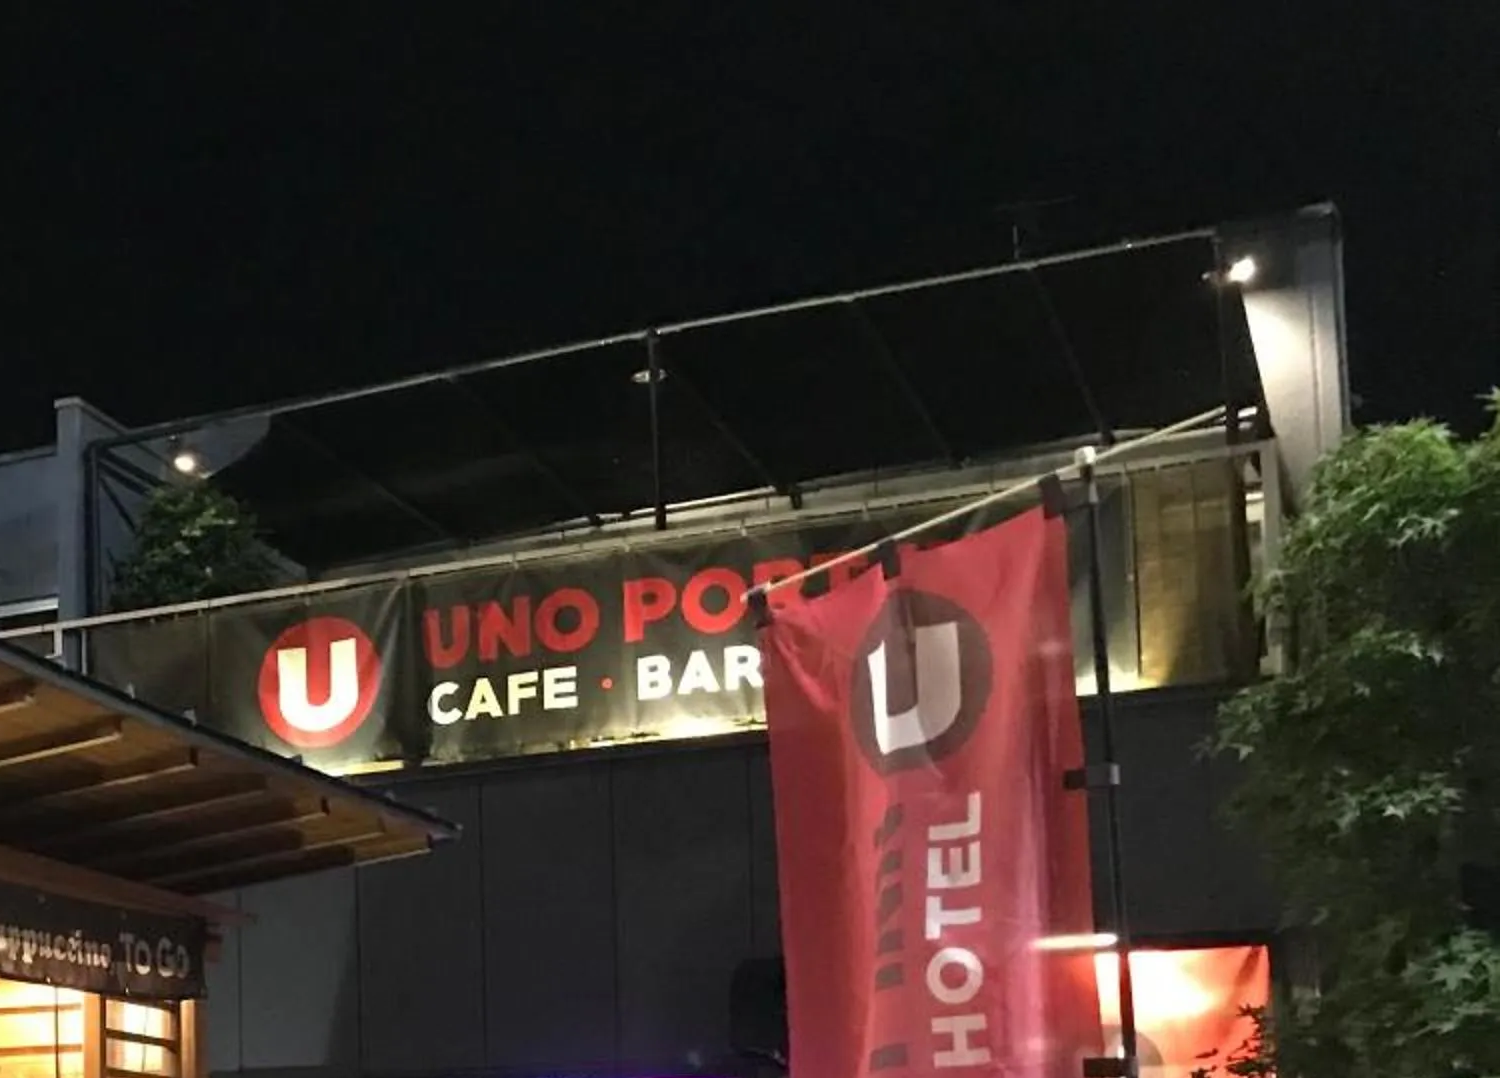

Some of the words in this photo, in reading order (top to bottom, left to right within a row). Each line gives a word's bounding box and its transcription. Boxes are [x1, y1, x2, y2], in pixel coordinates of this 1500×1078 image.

[422, 586, 600, 671] UNO
[275, 636, 360, 734] U
[426, 665, 579, 726] CAFE
[636, 643, 763, 703] BAR
[866, 620, 963, 756] U
[925, 791, 991, 1069] HOTEL
